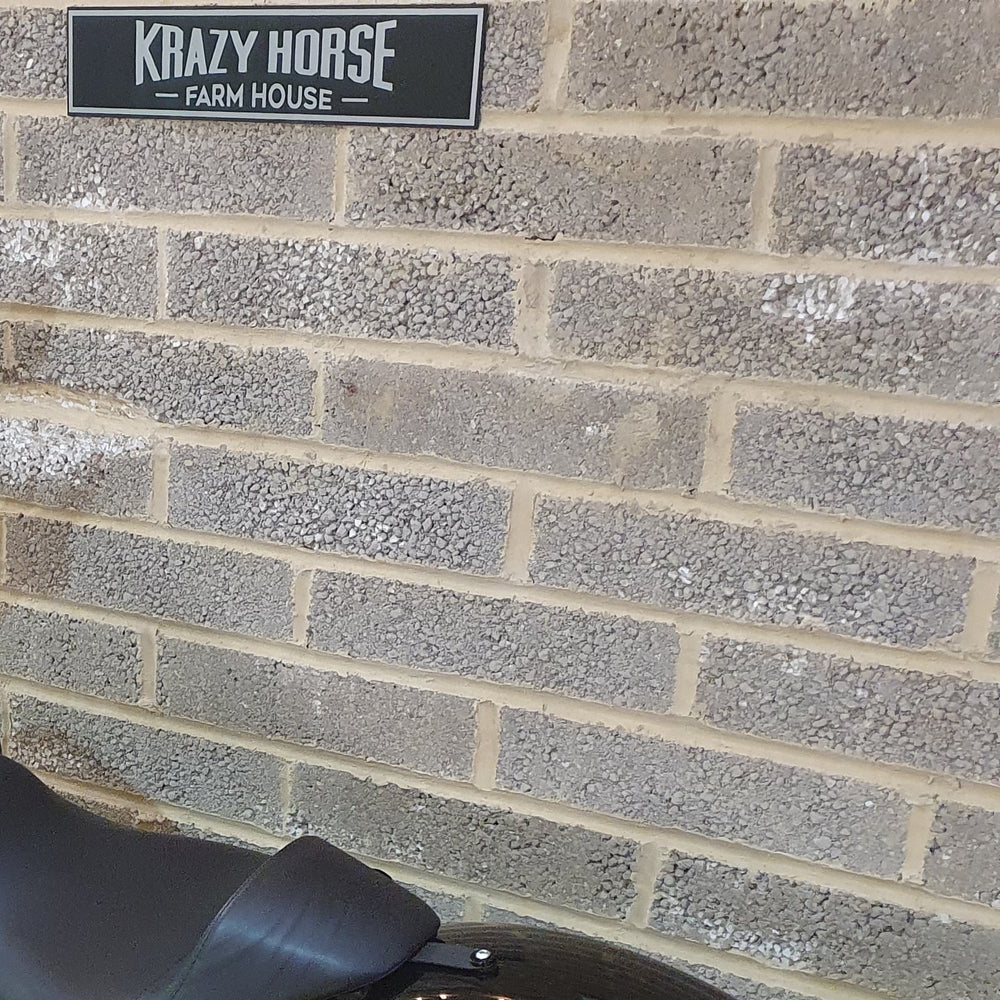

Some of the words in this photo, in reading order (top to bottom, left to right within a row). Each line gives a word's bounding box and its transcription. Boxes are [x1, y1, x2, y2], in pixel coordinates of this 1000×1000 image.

[135, 19, 258, 86] KRAZY
[268, 19, 398, 91] HORSE
[185, 84, 244, 108] FARM
[251, 82, 332, 110] HOUSE
